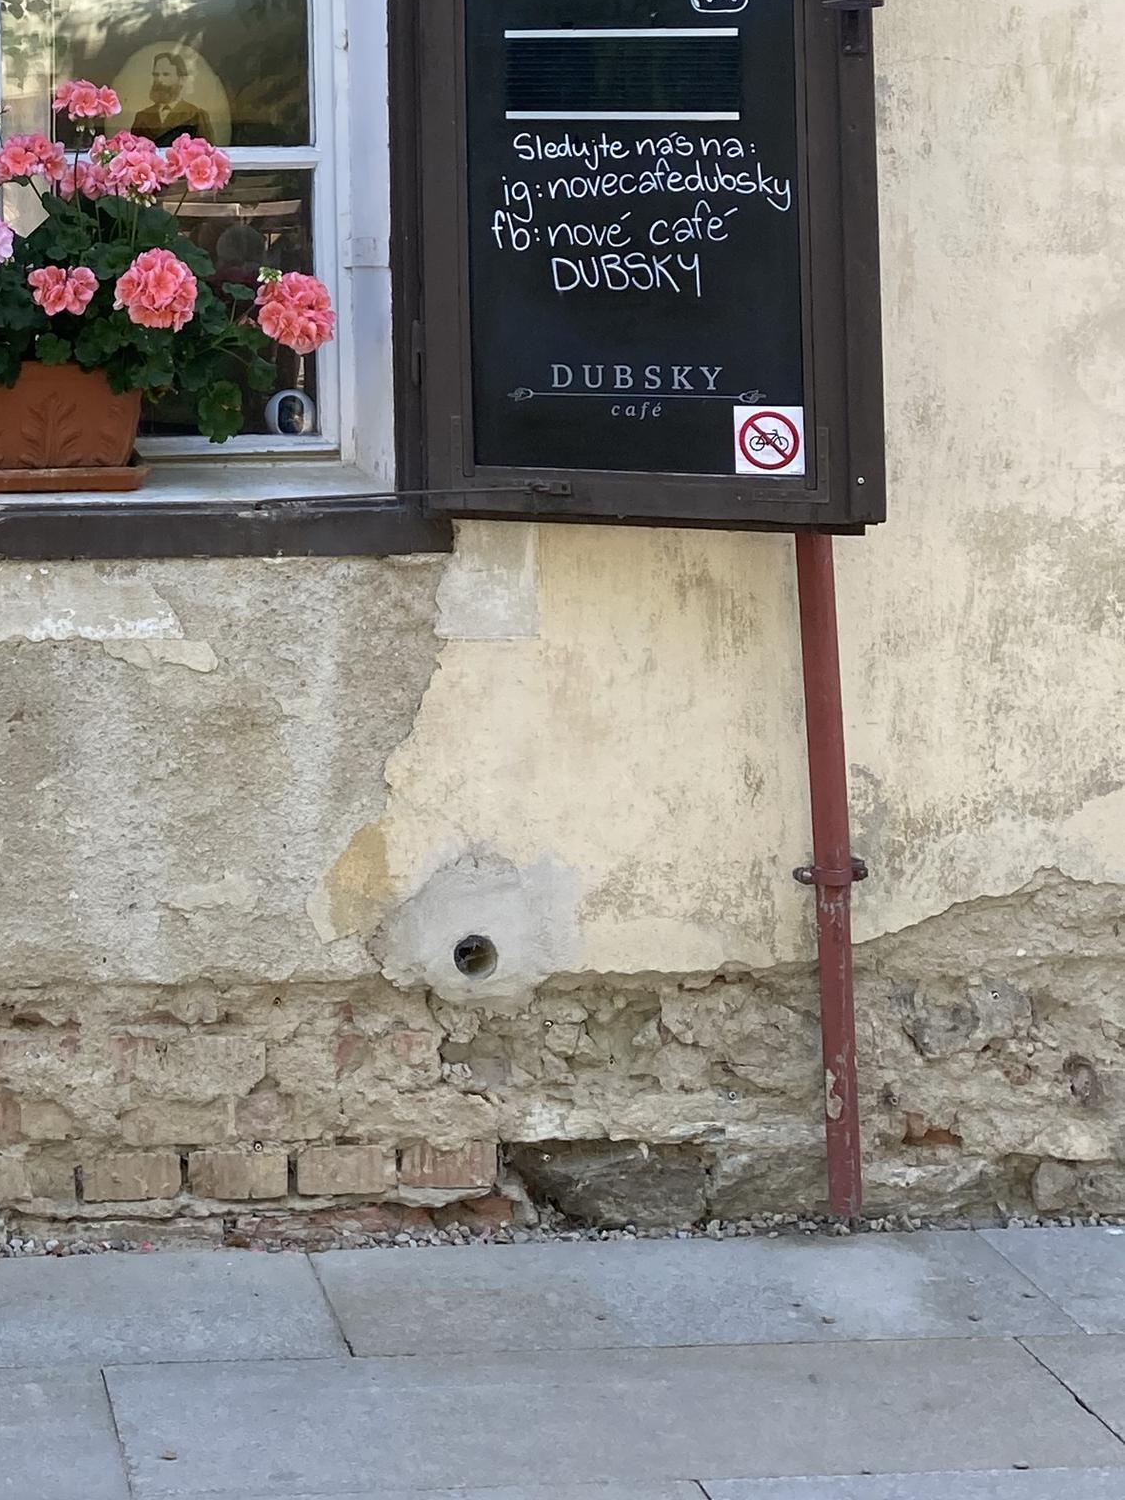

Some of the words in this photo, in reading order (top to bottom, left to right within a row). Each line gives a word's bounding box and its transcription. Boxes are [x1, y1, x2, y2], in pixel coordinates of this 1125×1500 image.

[512, 131, 630, 170] Sledujte
[635, 131, 694, 157] nás
[548, 211, 632, 248] nové
[649, 199, 739, 246] café
[551, 252, 702, 297] DUBSKY
[550, 363, 723, 390] DUBSKY
[610, 401, 663, 420] café
